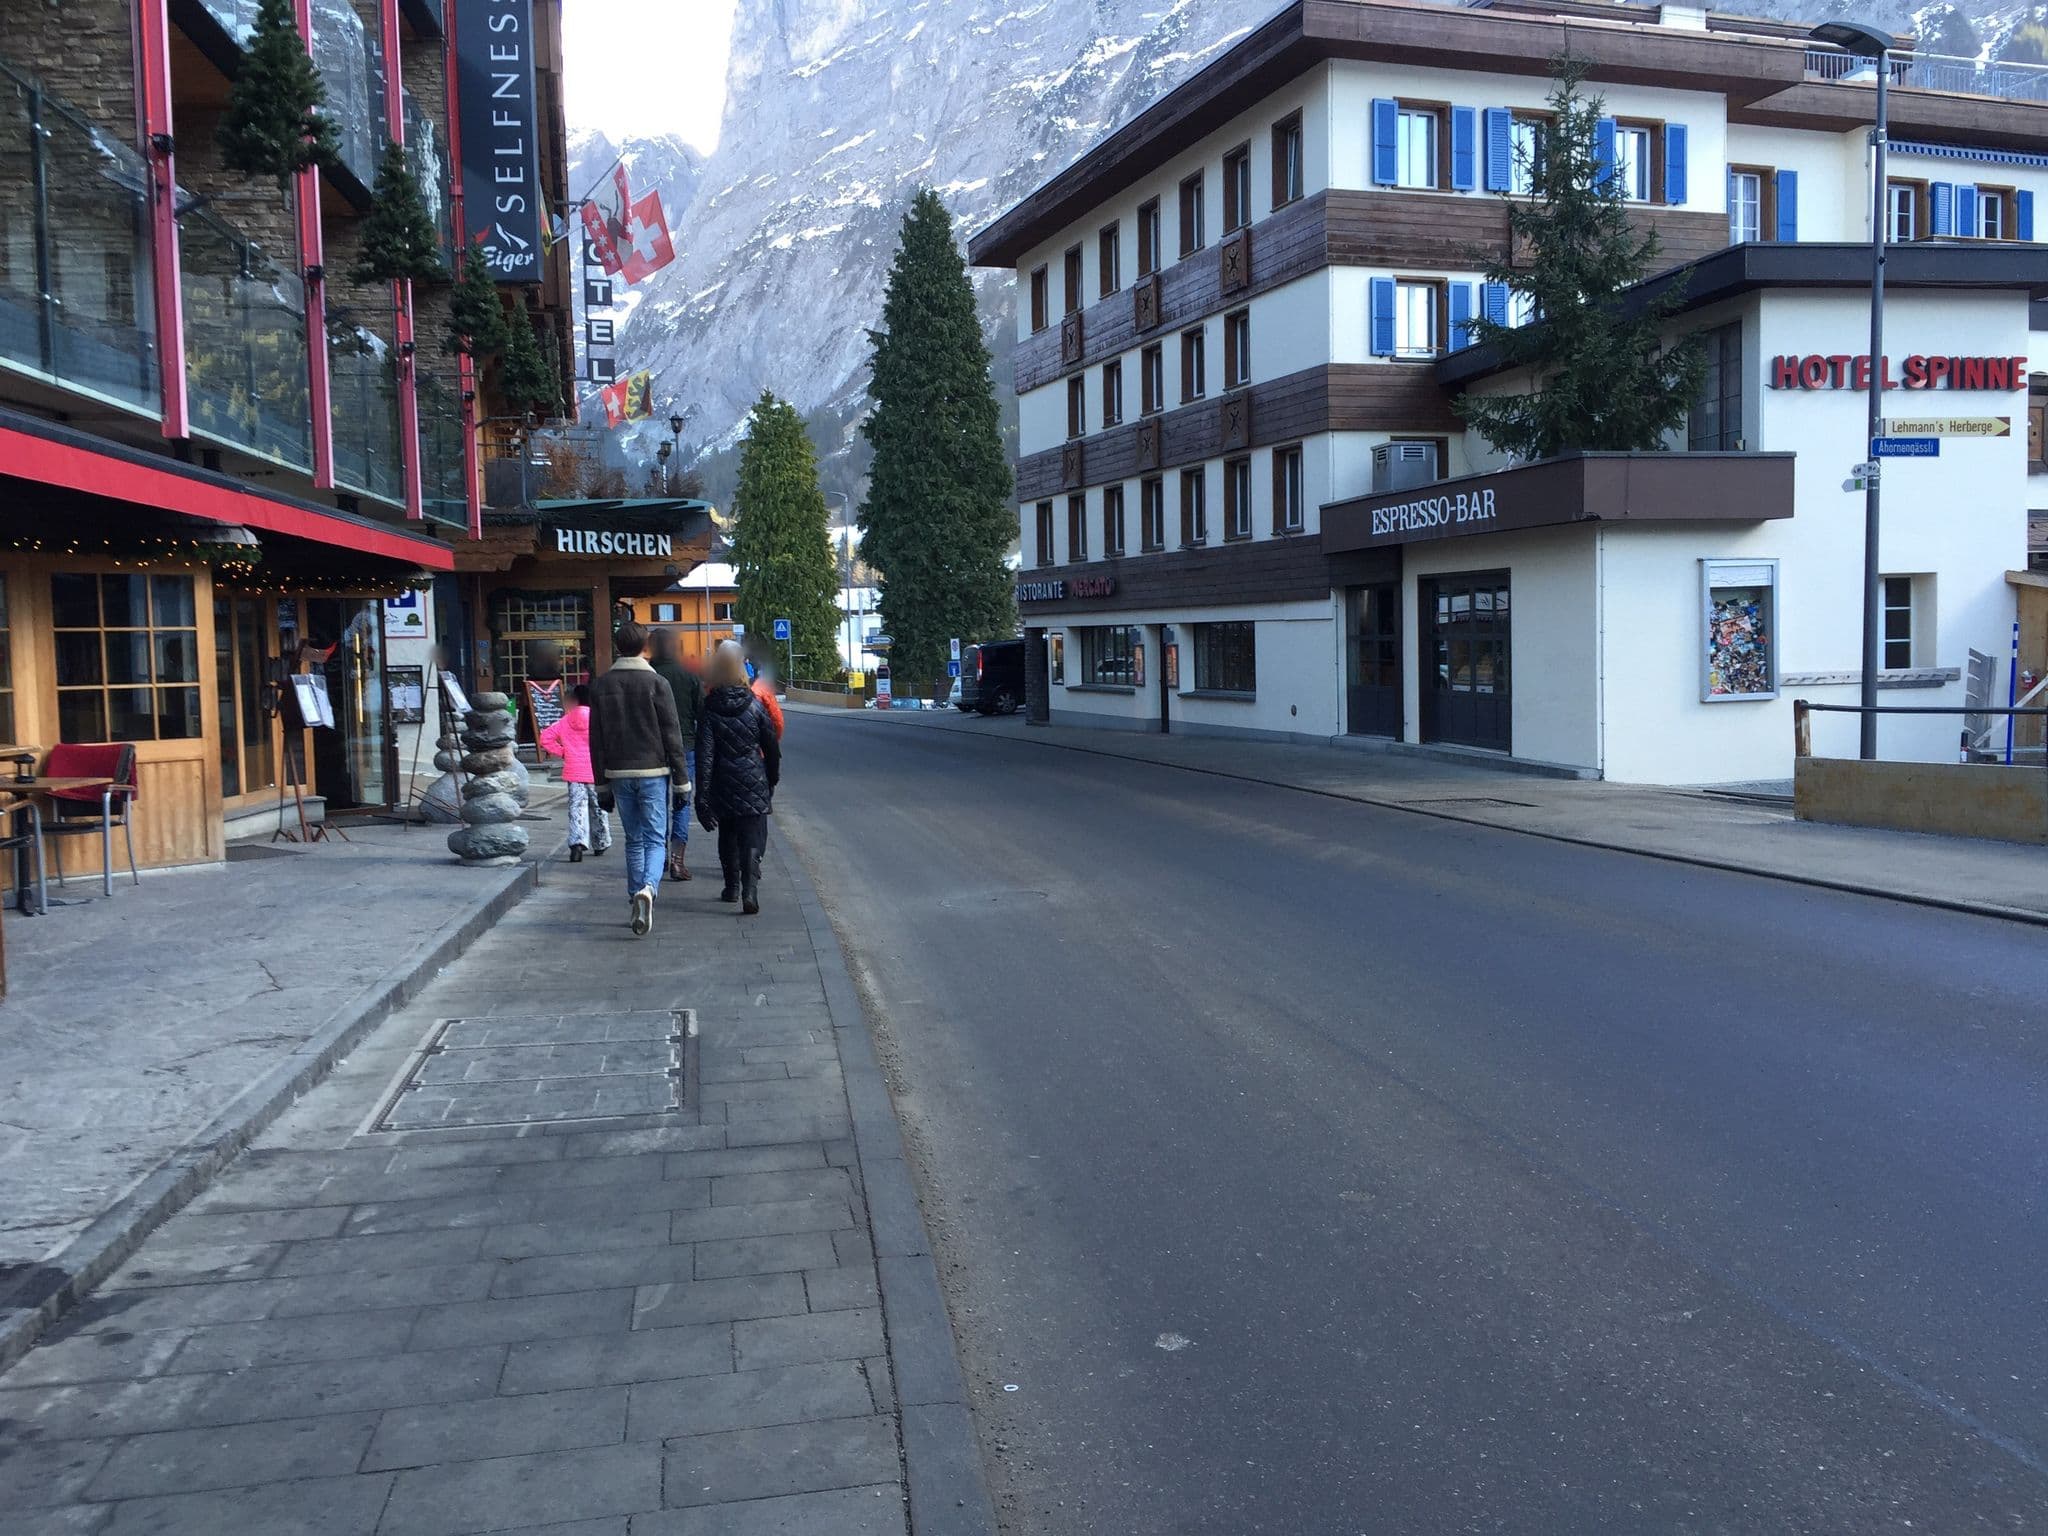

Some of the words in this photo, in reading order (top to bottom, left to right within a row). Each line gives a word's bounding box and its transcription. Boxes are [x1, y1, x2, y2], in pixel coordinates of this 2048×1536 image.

[488, 0, 525, 213] SELFNES
[481, 245, 535, 273] Eiger
[1774, 354, 1898, 389] HOTEL
[1903, 354, 2028, 390] SPINNE
[1892, 420, 1944, 434] Lehmann's
[1949, 420, 1993, 435] Herberge
[1878, 440, 1934, 456] Ahornengässli
[1371, 488, 1497, 536] ESPRESSO-BAR
[555, 528, 672, 557] HIRSCHEN
[1014, 580, 1064, 601] RISTORANTE
